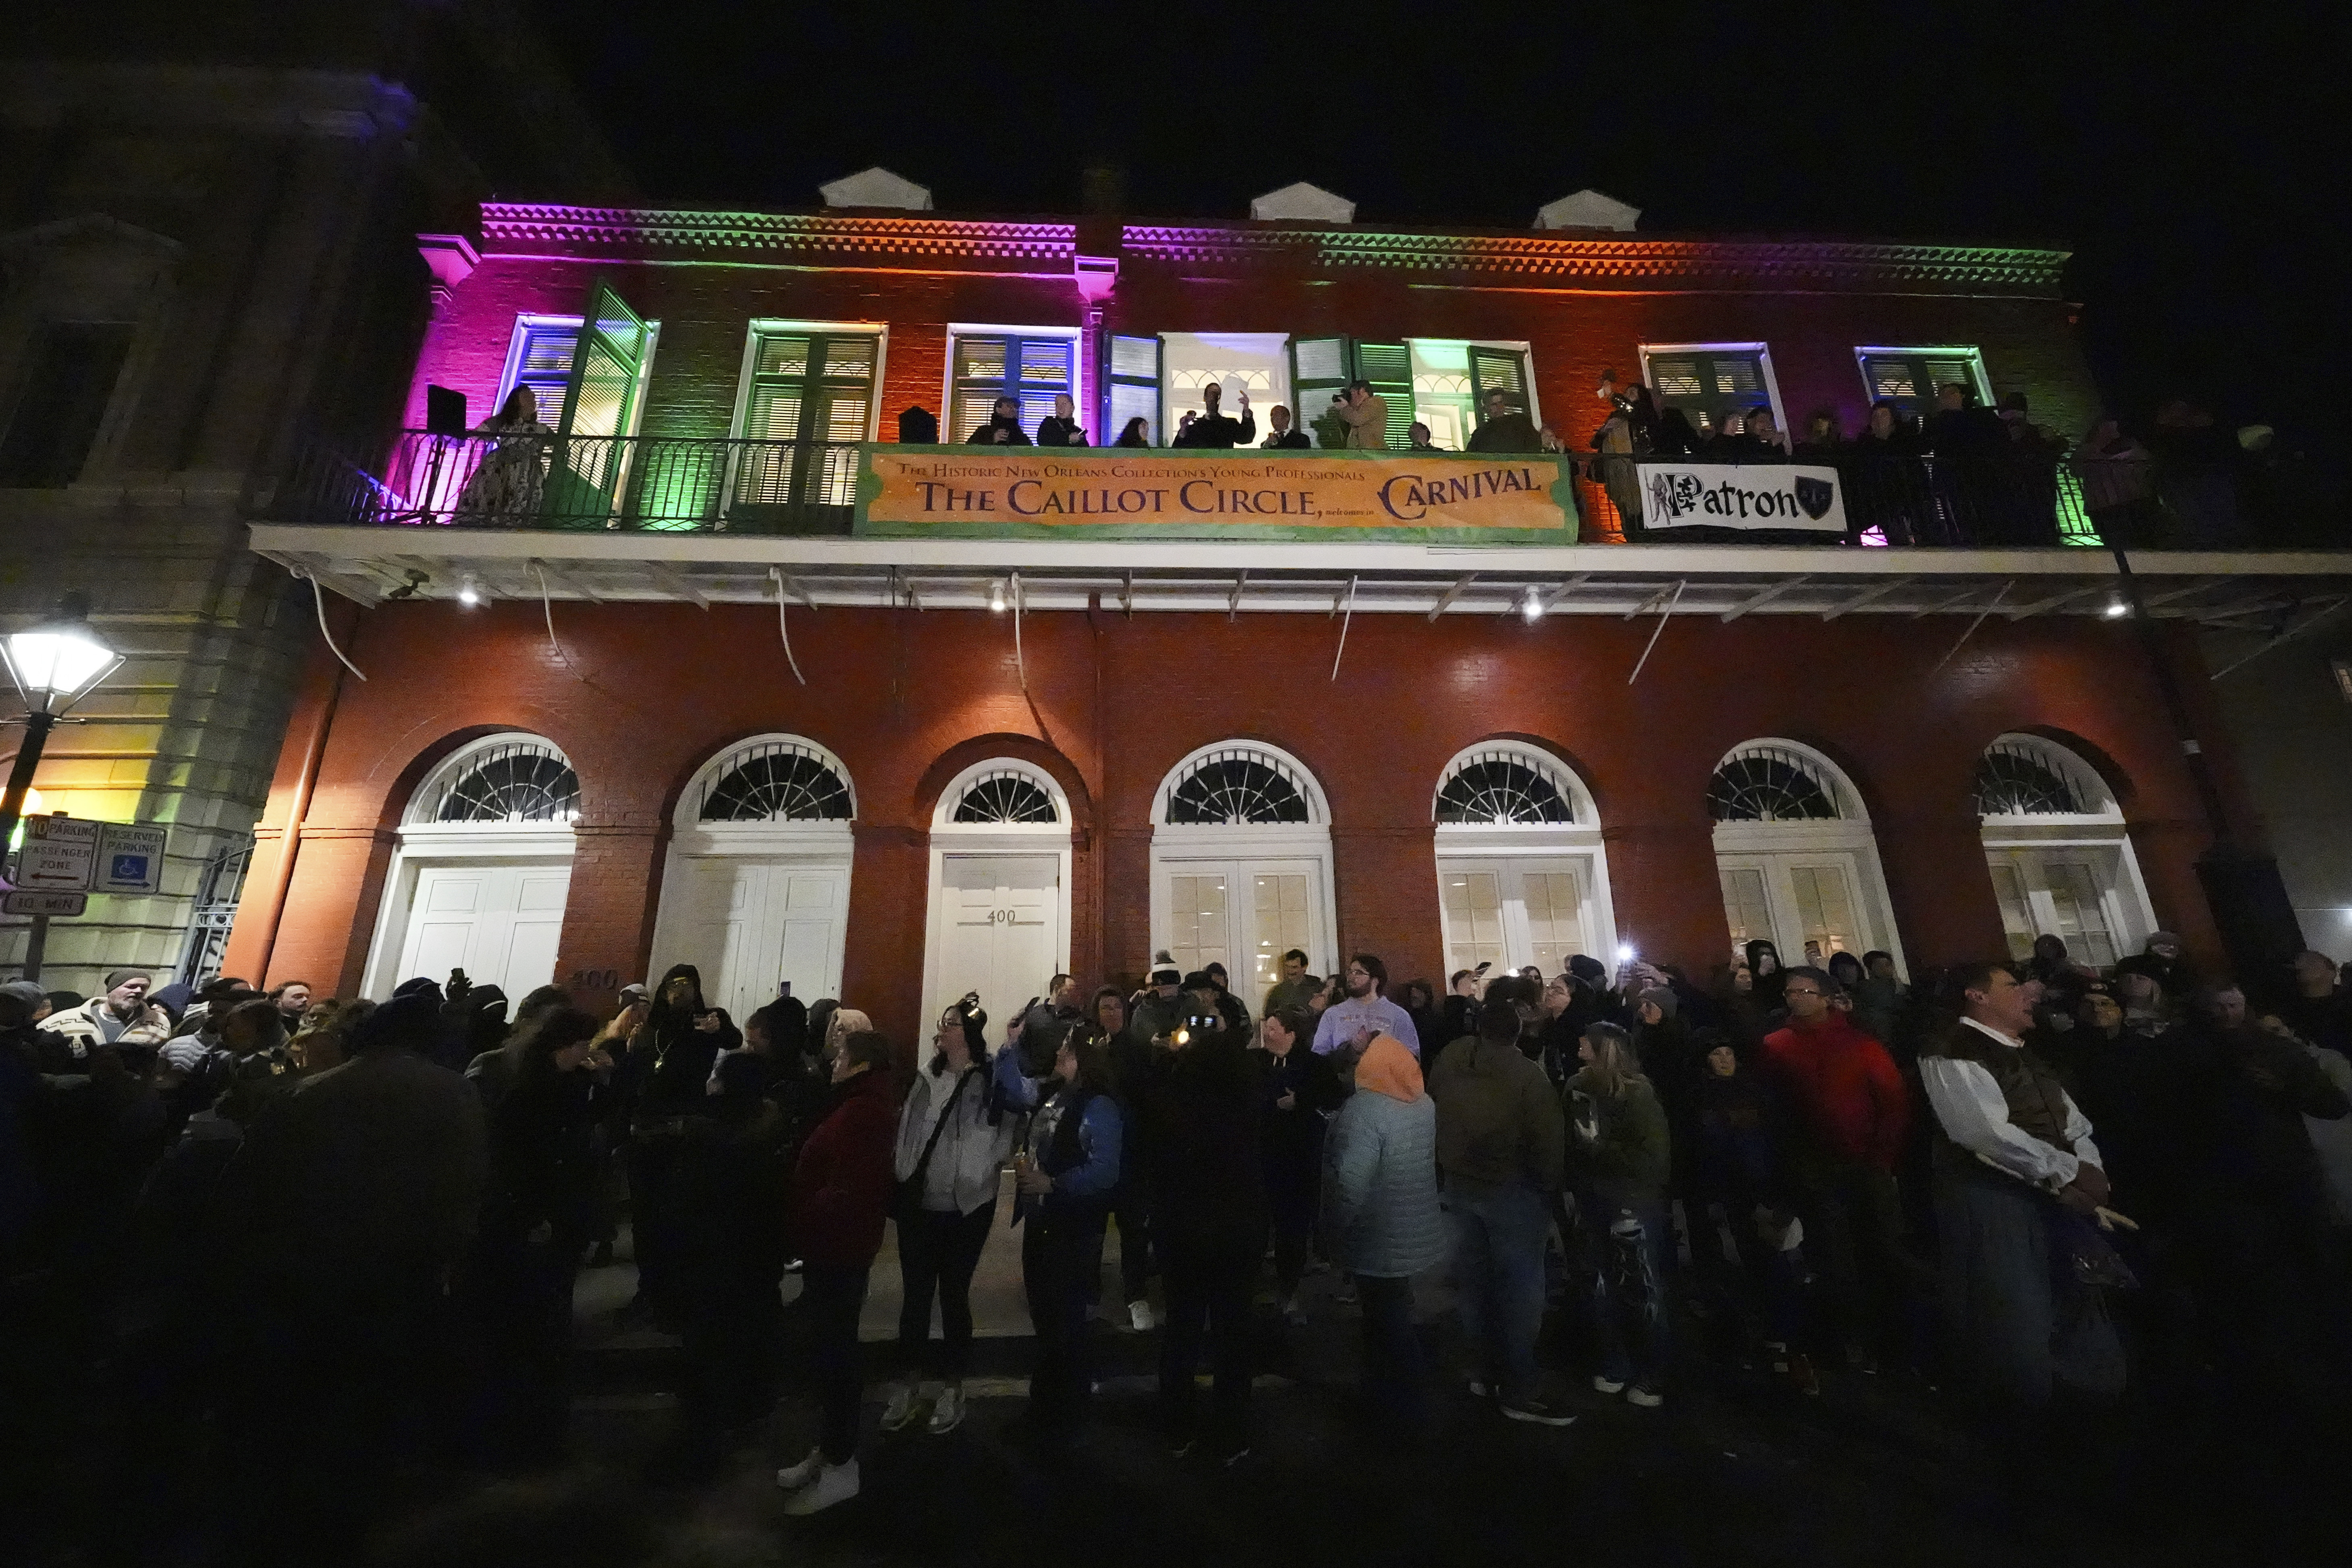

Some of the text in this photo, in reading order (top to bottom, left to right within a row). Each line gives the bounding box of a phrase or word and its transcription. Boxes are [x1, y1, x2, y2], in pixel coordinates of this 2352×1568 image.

[1662, 472, 1800, 518] Patron
[48, 824, 96, 837] PARKING
[25, 846, 90, 858] PASSENGER
[40, 860, 71, 870] ZONE
[987, 910, 1015, 922] 400
